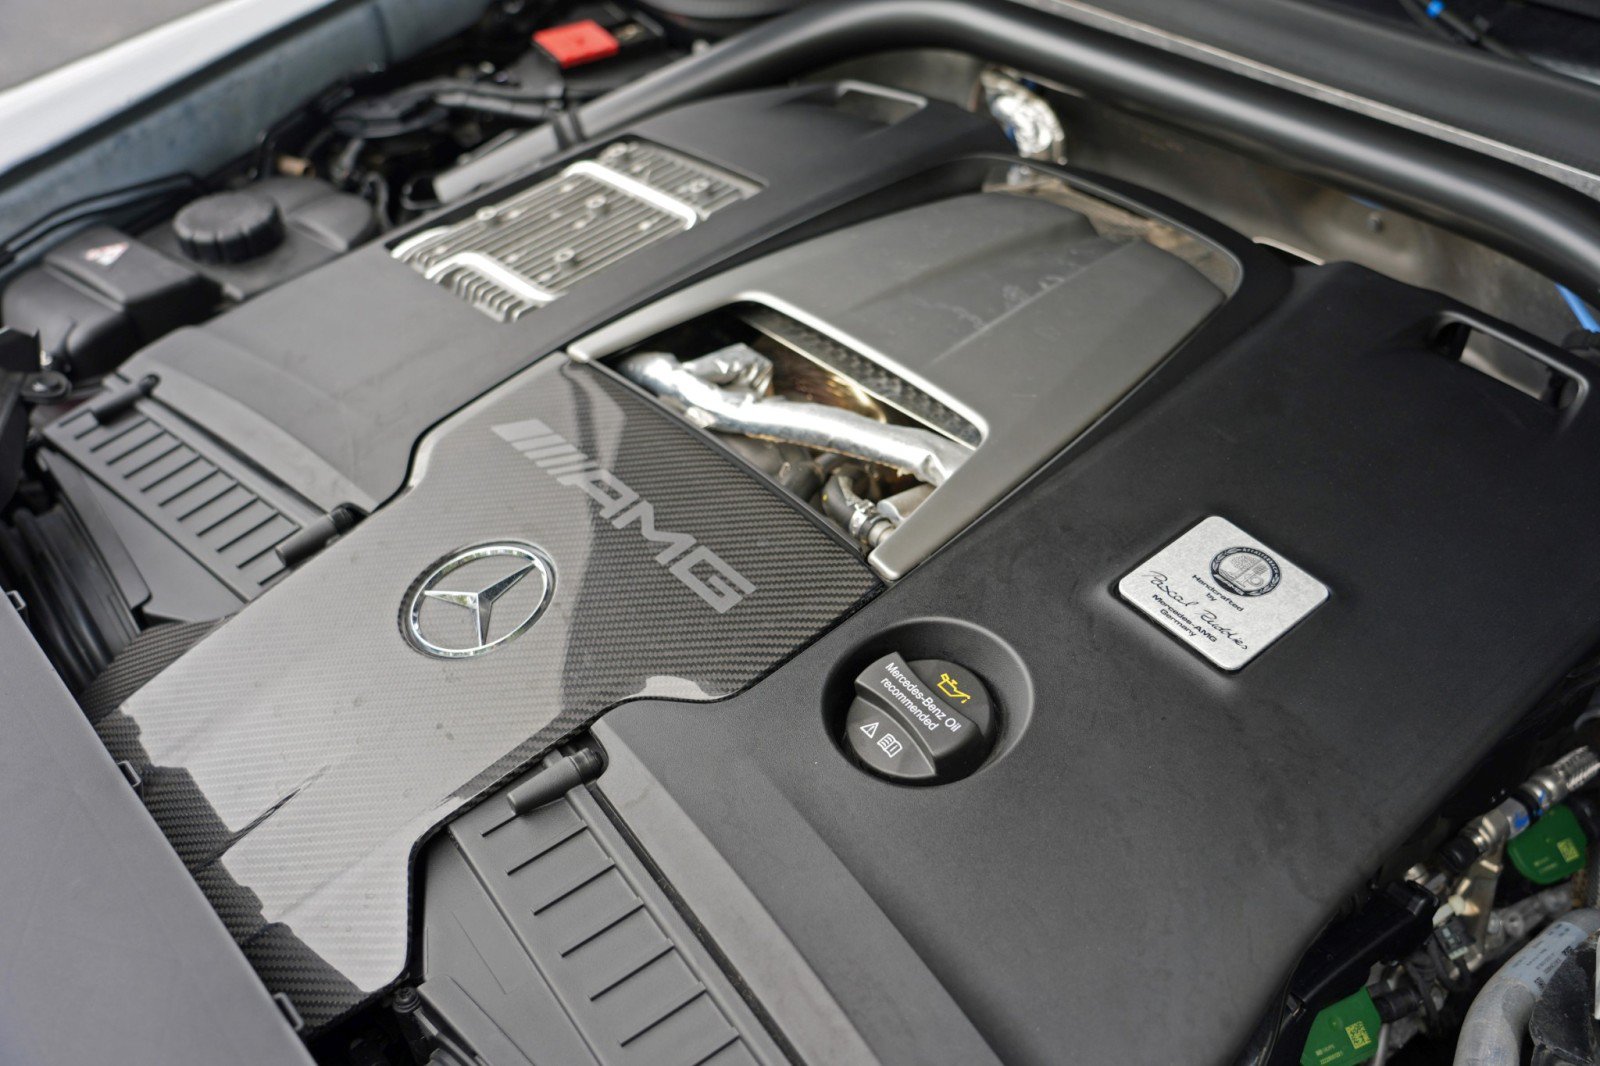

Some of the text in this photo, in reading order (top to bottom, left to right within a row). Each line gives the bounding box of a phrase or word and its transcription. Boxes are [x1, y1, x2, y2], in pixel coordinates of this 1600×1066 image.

[557, 468, 757, 614] AMG
[1192, 574, 1244, 612] Handcrafted
[1206, 592, 1217, 602] by
[1152, 594, 1218, 643] Mercedes-AMG
[1160, 608, 1197, 637] Germany
[880, 677, 940, 731] recommended
[885, 662, 962, 733] Mercedes-Benz Oil
